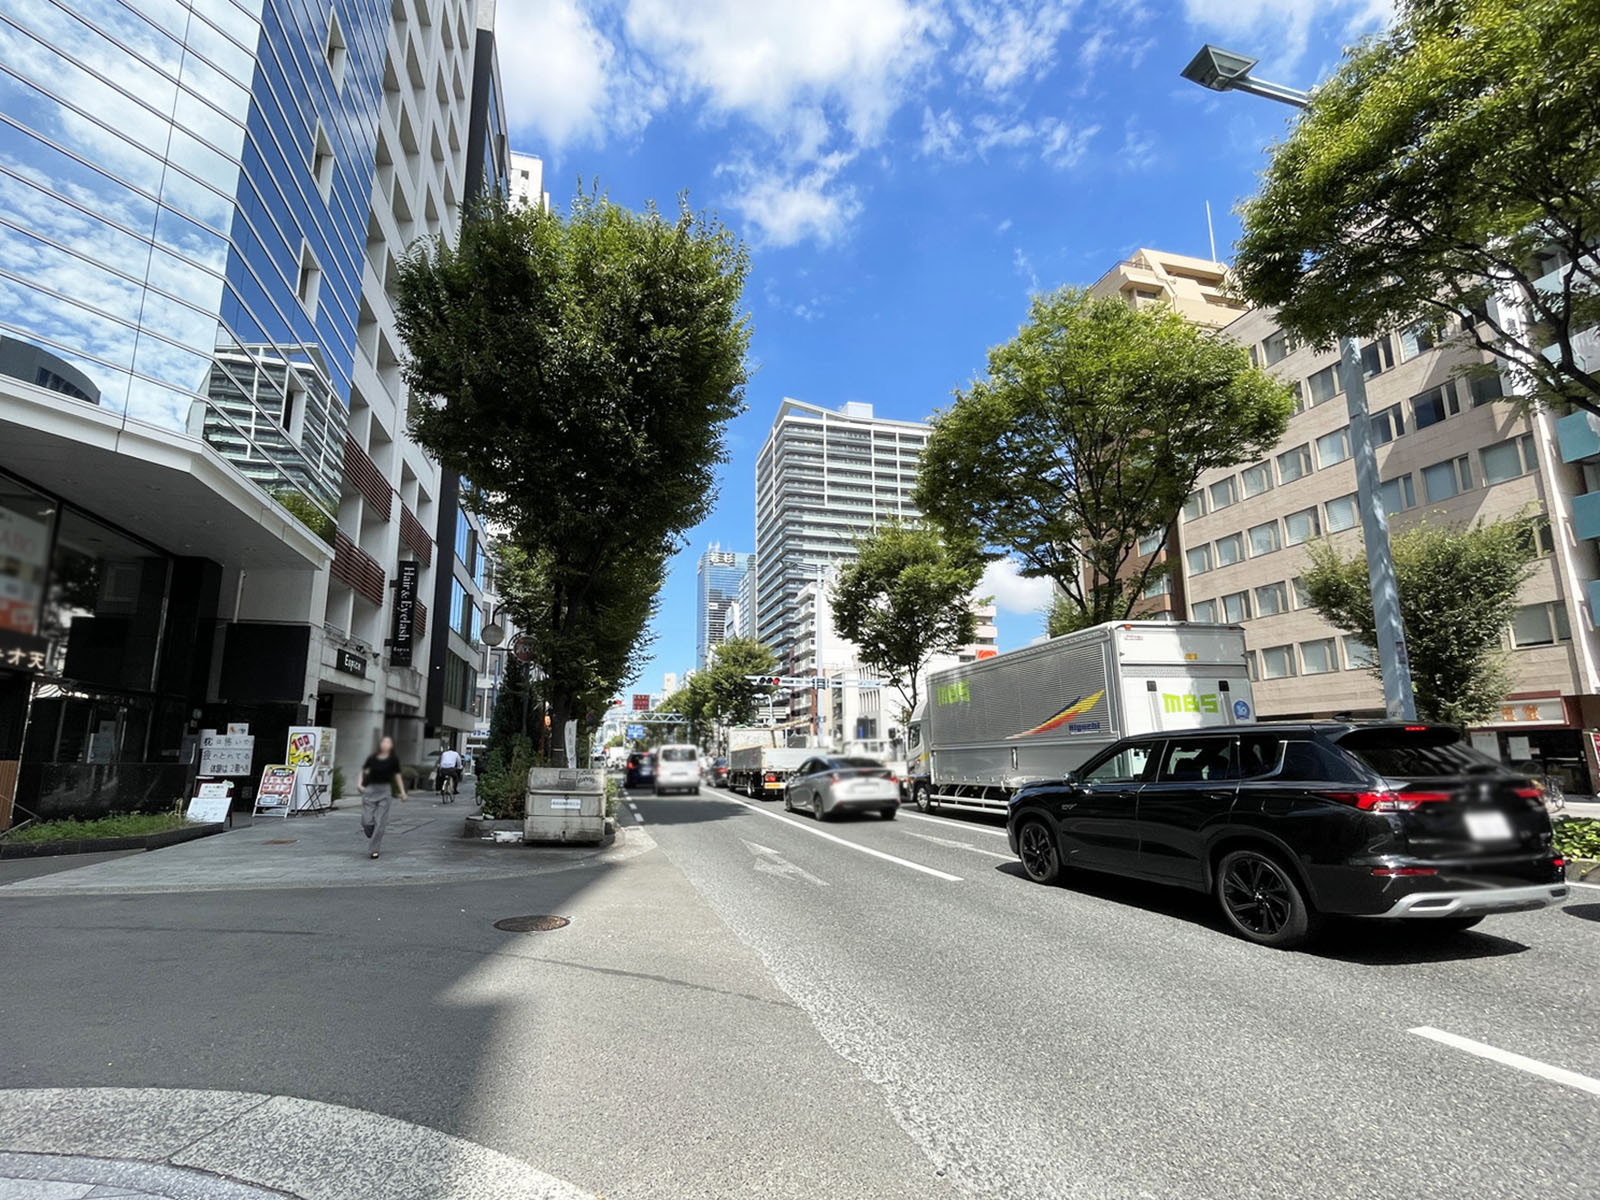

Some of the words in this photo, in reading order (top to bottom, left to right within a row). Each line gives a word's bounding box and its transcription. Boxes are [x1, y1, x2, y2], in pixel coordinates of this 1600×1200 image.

[402, 567, 415, 590] Hair
[397, 600, 413, 641] Eyelash
[0, 648, 45, 670] 才天
[1161, 692, 1219, 714] MBS
